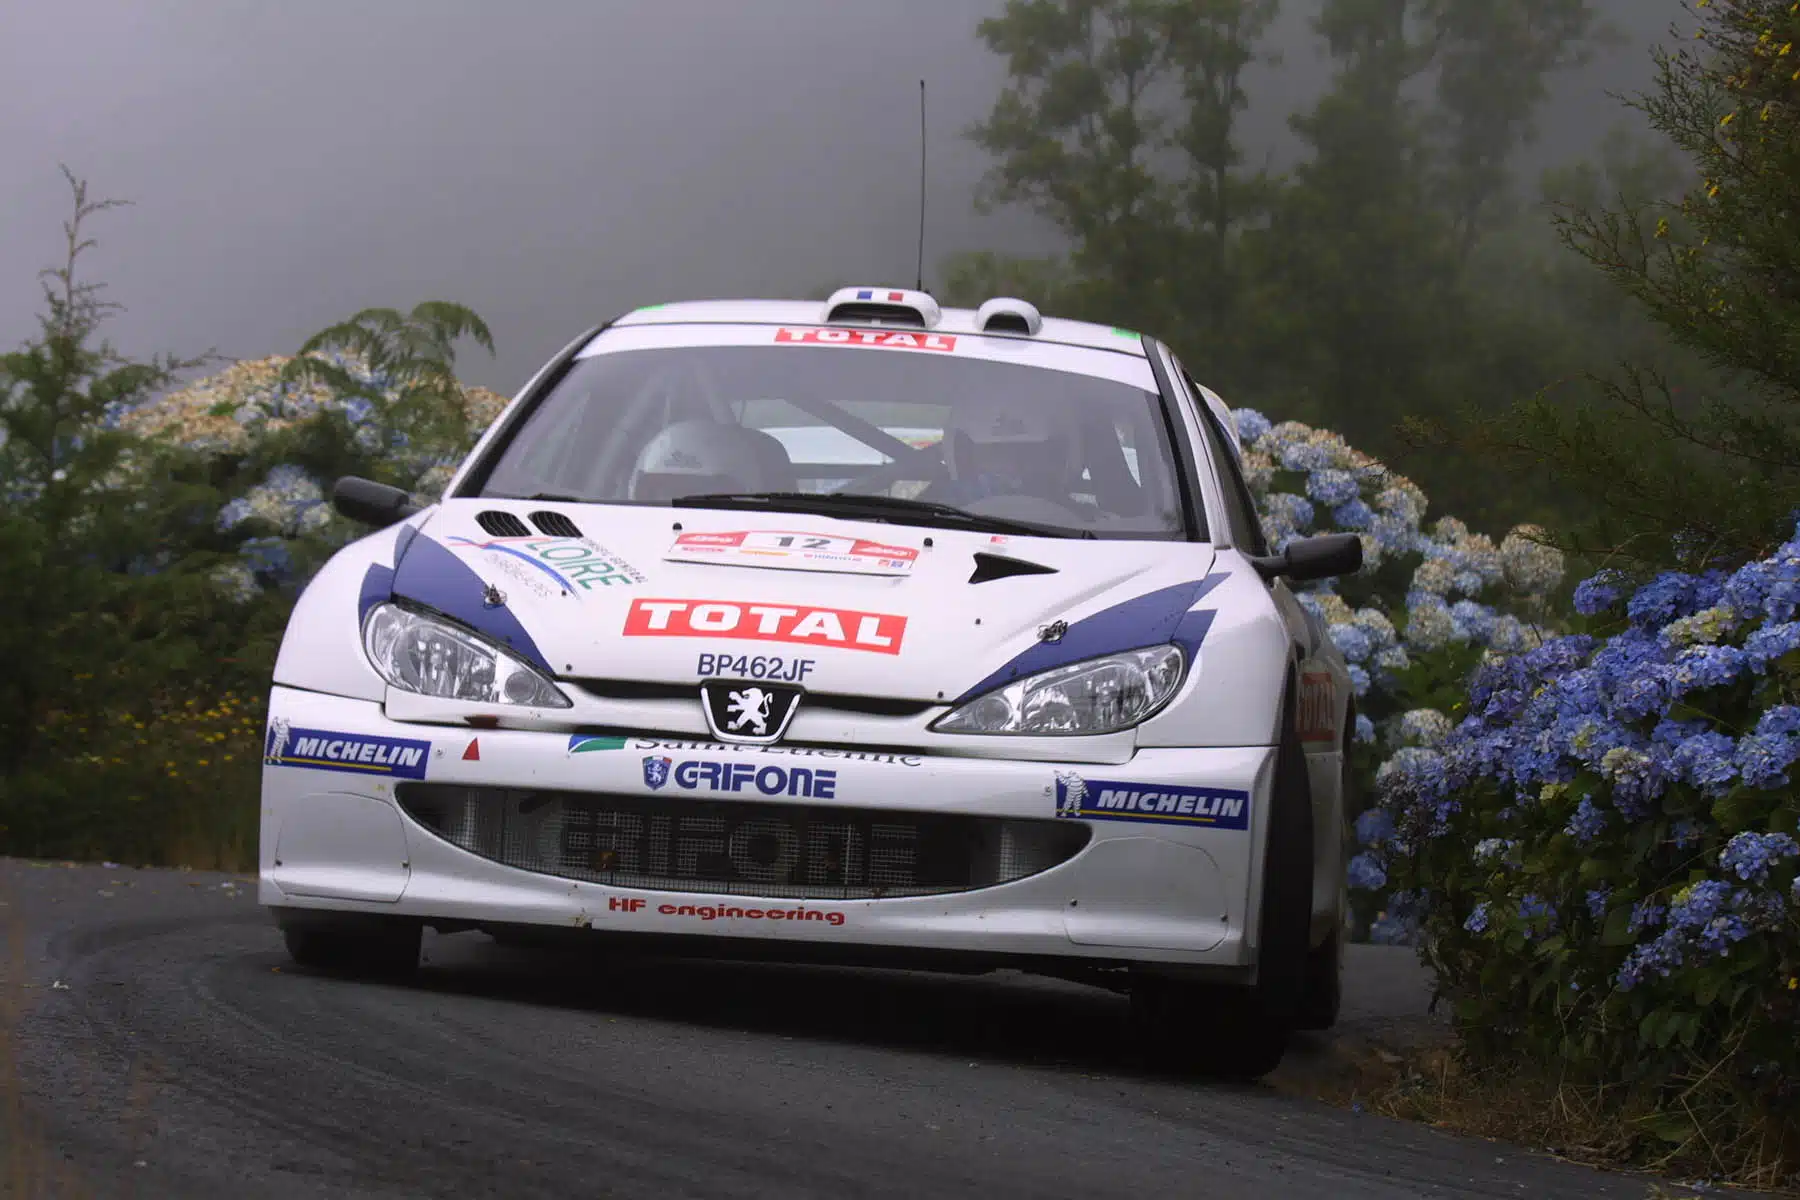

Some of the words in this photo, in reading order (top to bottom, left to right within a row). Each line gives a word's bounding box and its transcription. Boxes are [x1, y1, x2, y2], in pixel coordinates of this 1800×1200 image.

[783, 327, 949, 349] TOTAL
[775, 535, 832, 550] 12
[525, 537, 633, 590] LOIRE
[639, 602, 894, 647] TOTAL
[696, 653, 816, 682] BP462JF
[293, 736, 424, 767] MICHELIN
[674, 760, 837, 799] GRIFONE
[1096, 789, 1245, 817] MICHELIN
[608, 896, 647, 914] HF
[657, 901, 845, 926] engineering
